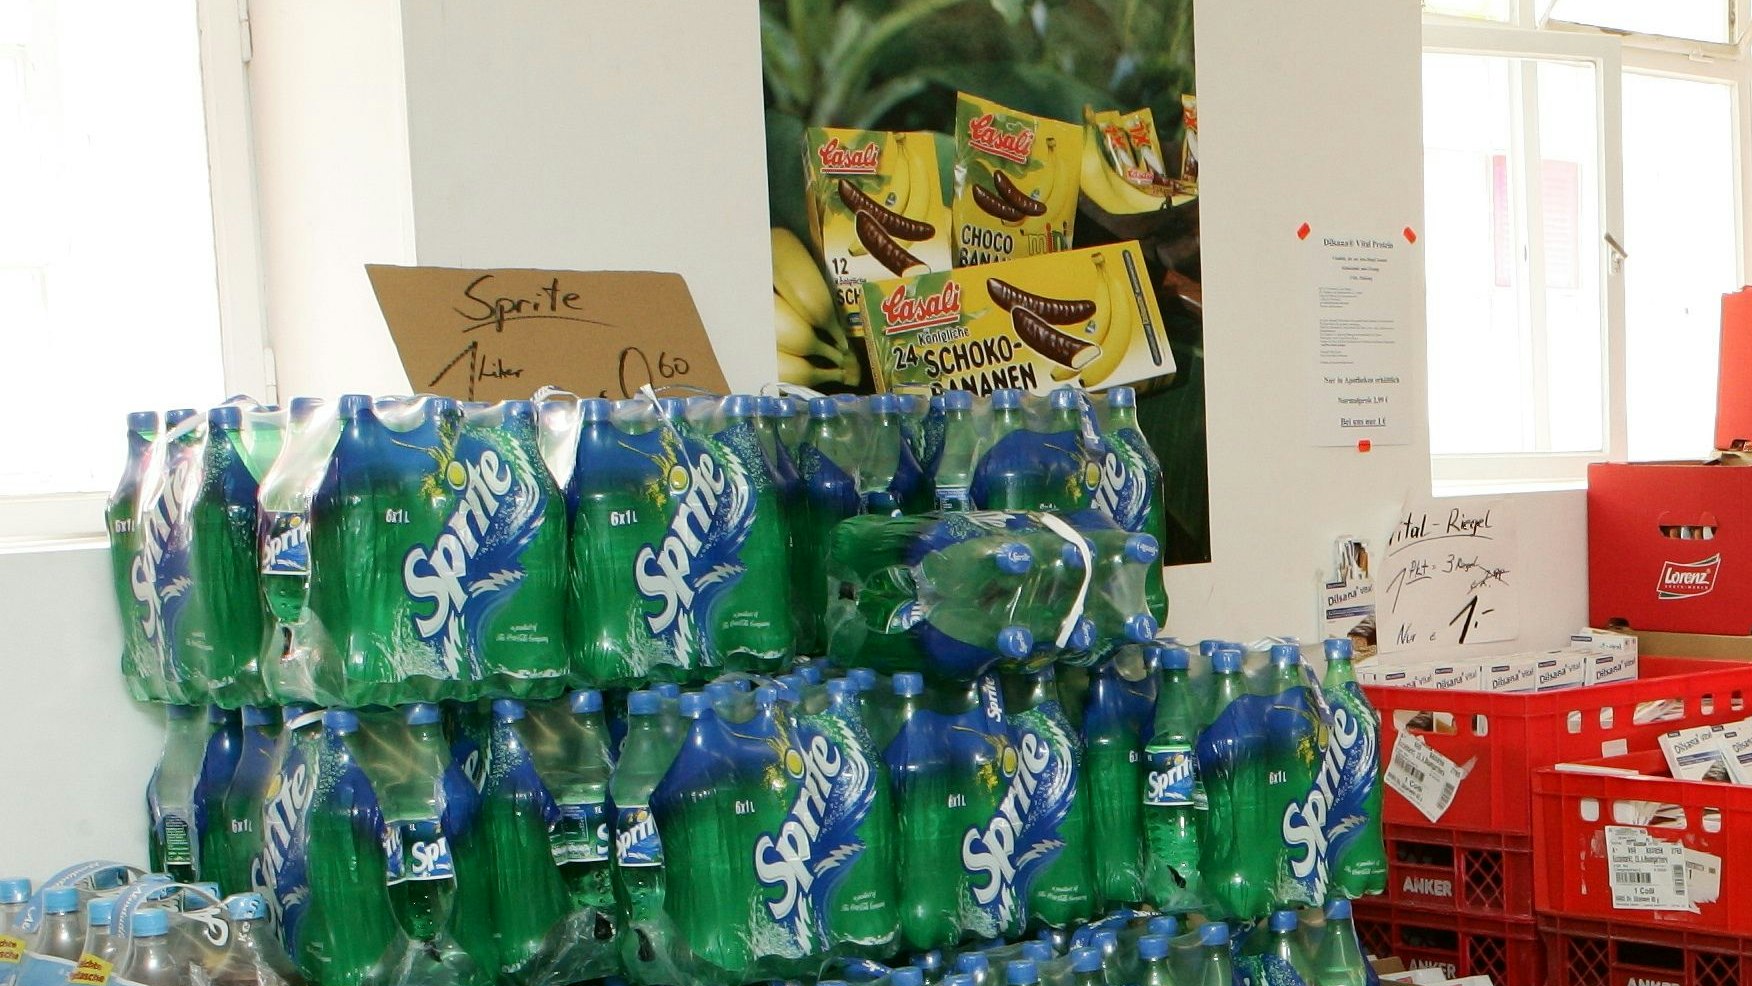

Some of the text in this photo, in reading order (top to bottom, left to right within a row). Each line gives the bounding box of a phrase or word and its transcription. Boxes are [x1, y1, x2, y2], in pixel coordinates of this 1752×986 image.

[818, 137, 880, 170] Casali
[969, 113, 1035, 162] Casali
[960, 224, 1014, 254] CHOCO
[832, 257, 850, 275] 12
[453, 274, 584, 334] Sprite
[880, 279, 962, 330] Casali
[428, 341, 478, 402] 1
[893, 345, 920, 370] 24
[923, 334, 1024, 378] SCHOKO-
[385, 509, 411, 525] 6x1L
[610, 510, 638, 526] 6x1L
[404, 449, 513, 638] Sprite
[637, 450, 725, 635] Sprite
[1665, 567, 1710, 586] Lorenz
[735, 800, 755, 815] 6x1L
[1283, 707, 1359, 879] Sprite
[231, 817, 253, 834] 6x1L
[754, 734, 842, 921] Sprite
[961, 731, 1050, 905] Sprite
[1402, 875, 1453, 897] ANKER
